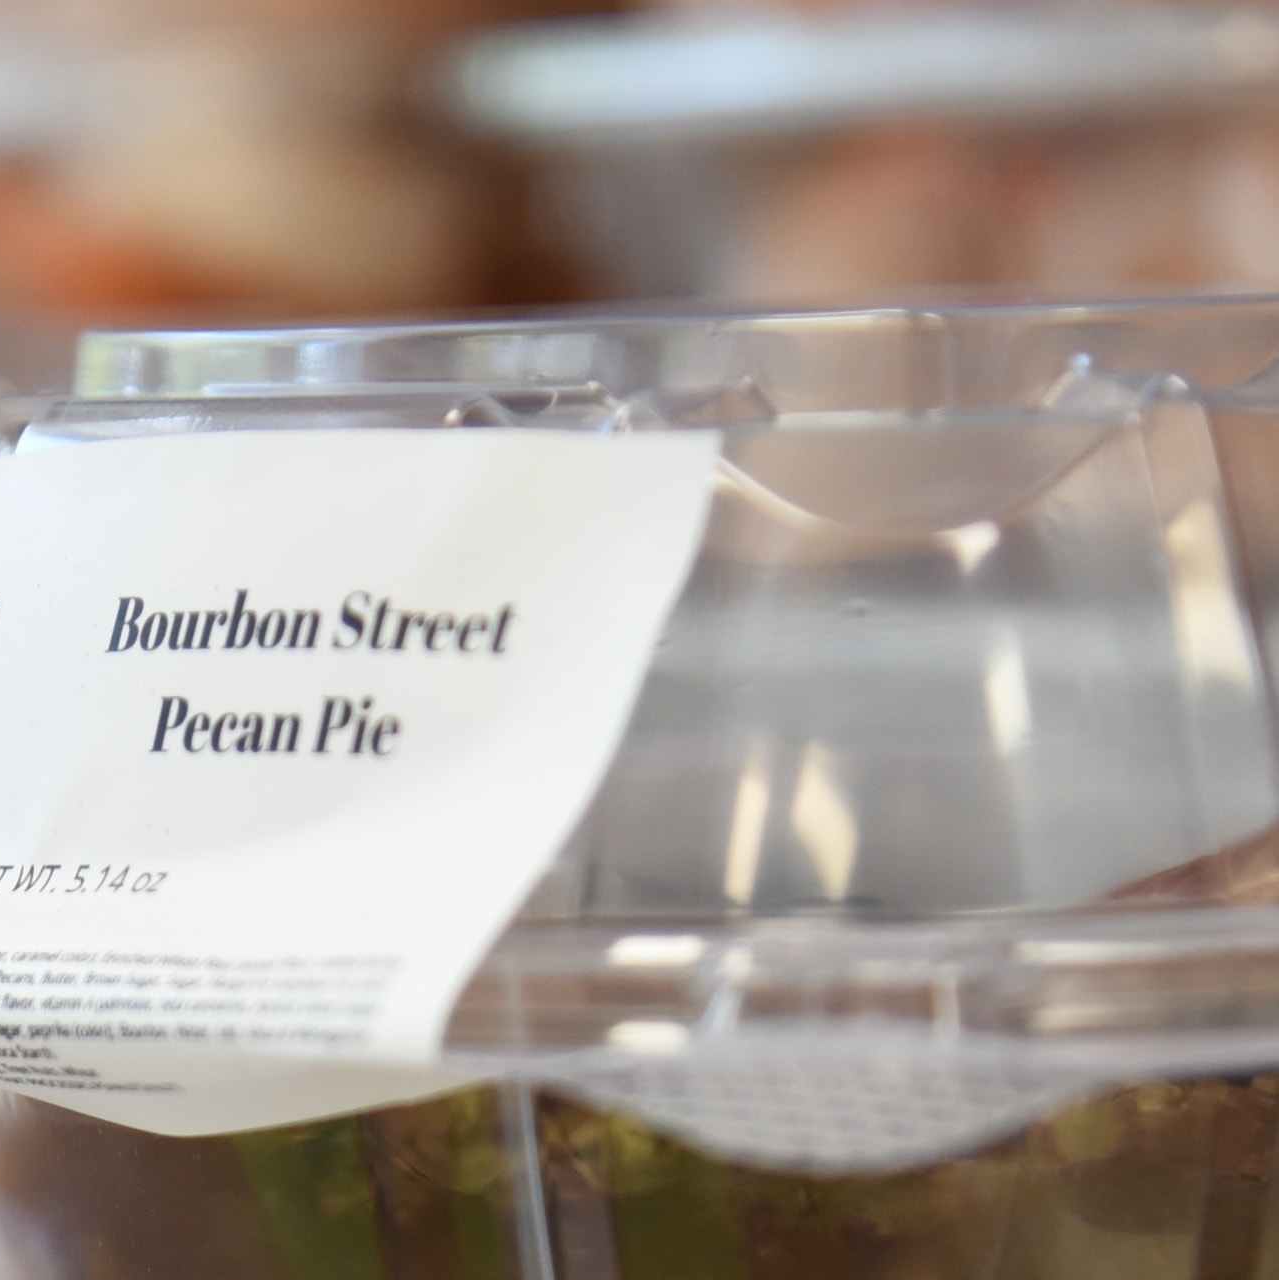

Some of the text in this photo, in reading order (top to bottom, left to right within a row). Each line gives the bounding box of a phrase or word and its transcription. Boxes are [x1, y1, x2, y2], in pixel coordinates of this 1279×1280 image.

[105, 589, 516, 654] Bourbon Street
[149, 695, 401, 756] Pecan Pie
[12, 864, 61, 894] WT.
[66, 864, 131, 894] 5.14
[131, 871, 168, 895] oz
